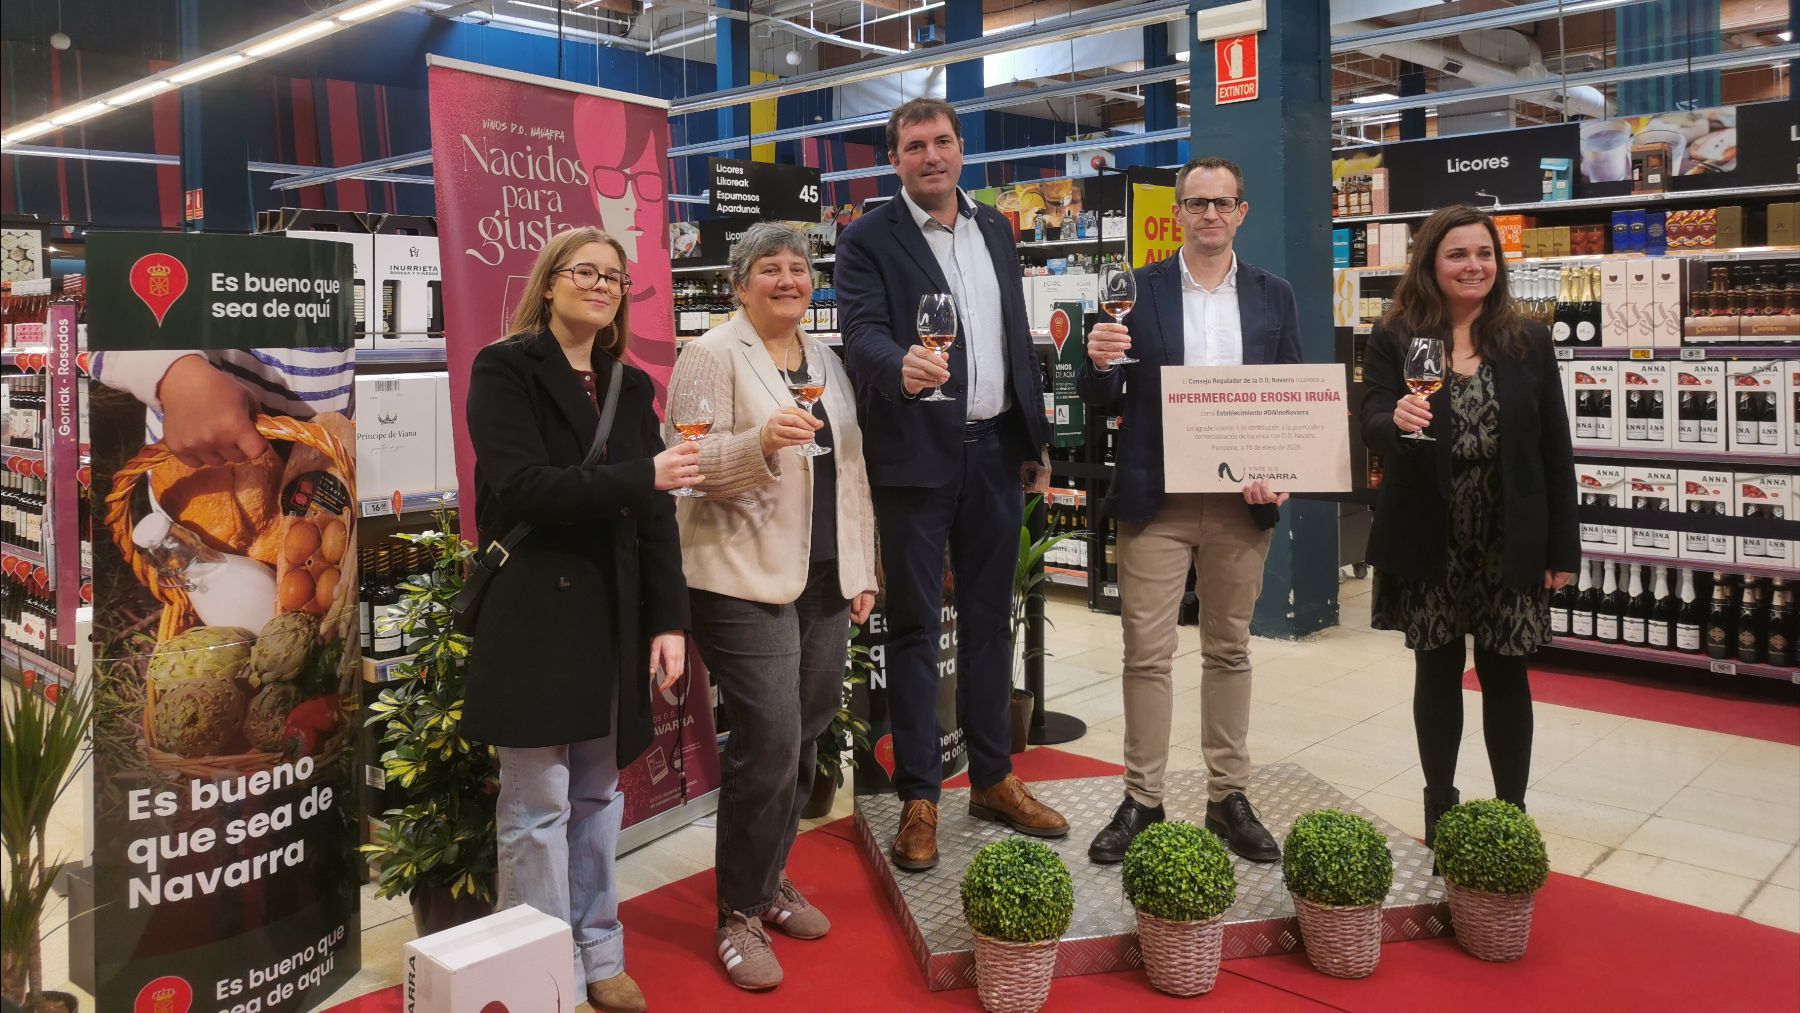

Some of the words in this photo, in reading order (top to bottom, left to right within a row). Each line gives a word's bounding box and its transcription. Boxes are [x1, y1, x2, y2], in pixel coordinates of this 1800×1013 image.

[1219, 83, 1255, 99] EXTINTOR
[530, 127, 565, 143] NAVARRA
[461, 133, 589, 186] Nacidos
[1447, 155, 1509, 173] Licores
[716, 163, 744, 175] Licores
[716, 176, 749, 188] Likoreak
[502, 183, 563, 218] para
[716, 190, 760, 203] Espumosos
[799, 184, 819, 203] 45
[716, 203, 760, 215] Apardunak
[465, 209, 574, 266] gust
[211, 273, 238, 293] Es
[244, 272, 311, 294] bueno
[314, 279, 340, 299] que
[211, 301, 258, 318] sea
[263, 299, 291, 318] de
[294, 298, 331, 324] aquí
[57, 318, 70, 375] Rosados
[1055, 363, 1072, 371] VINOS
[1168, 392, 1257, 404] HIPERMERCADO
[1260, 391, 1302, 402] EROSKI
[1305, 388, 1341, 402] IRUÑA
[58, 387, 71, 436] Gorriak
[388, 430, 397, 439] de
[398, 429, 417, 438] Viana
[1596, 469, 1619, 477] ANNA
[1647, 472, 1672, 480] ANNA
[1702, 475, 1727, 483] ANNA
[1760, 478, 1787, 486] ANNA
[128, 788, 178, 822] Es
[191, 756, 314, 811] bueno
[127, 827, 216, 874] que
[225, 806, 293, 845] sea
[299, 783, 333, 822] de
[128, 839, 305, 909] Navarra
[216, 978, 243, 1000] Es
[249, 946, 315, 989] bueno
[317, 924, 345, 956] que
[266, 982, 294, 1007] de
[297, 951, 334, 991] aquí
